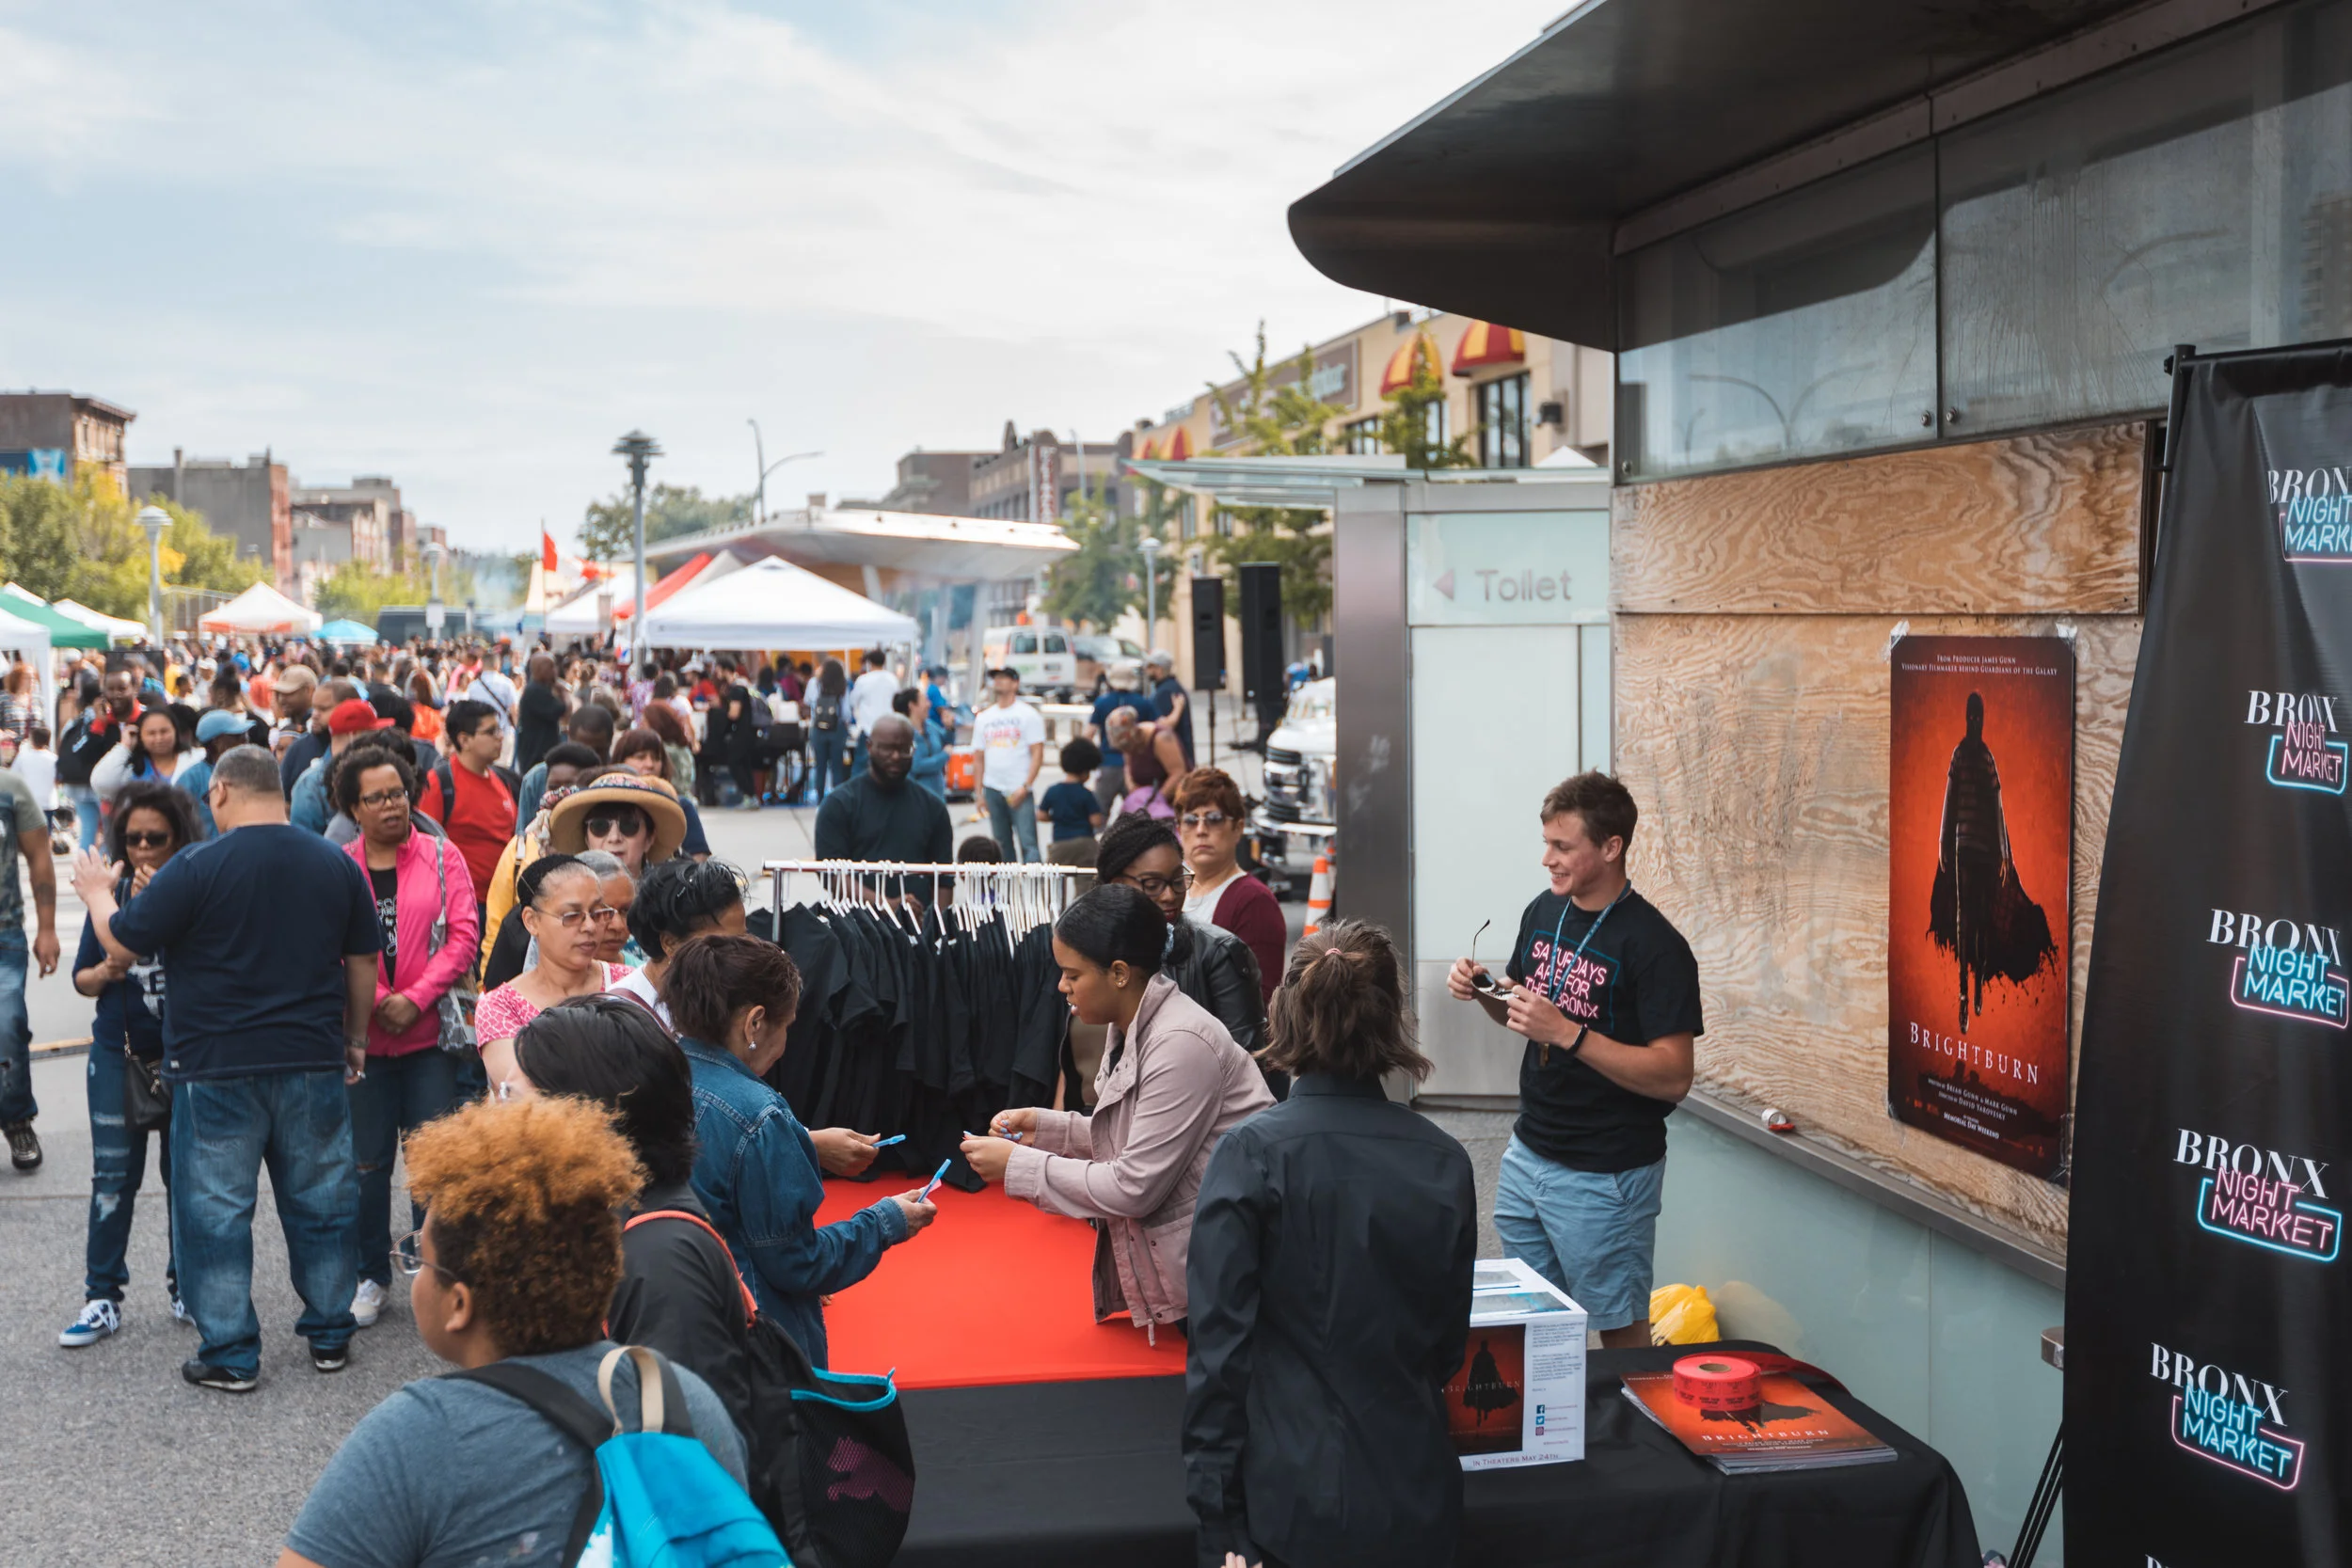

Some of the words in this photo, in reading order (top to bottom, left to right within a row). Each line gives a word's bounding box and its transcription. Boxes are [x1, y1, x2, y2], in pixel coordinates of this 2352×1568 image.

[2268, 466, 2352, 504] BRON
[2287, 496, 2352, 524] NIGHT
[2284, 524, 2352, 553] MARK
[1474, 568, 1572, 601] Toilet
[1999, 656, 2016, 665] GUNN
[2244, 689, 2339, 733] BRONX
[2285, 721, 2327, 752] NIGHT
[2281, 748, 2343, 784] MARKET
[2206, 908, 2342, 967] BRONX
[1532, 941, 1608, 987] SAURDAYS
[2248, 943, 2329, 983] NIGHT
[1564, 974, 1591, 1001] FOR
[2243, 970, 2346, 1019] MARKET
[1910, 1021, 2039, 1085] BRIGHTBURN
[2172, 1129, 2329, 1199] BRONX
[2216, 1166, 2300, 1212] NIGHT
[2211, 1194, 2334, 1250] MARKET
[2149, 1341, 2290, 1427] BRONX
[2185, 1384, 2264, 1436] NIGHT
[1701, 1429, 1830, 1441] BRIGHTBURN
[2183, 1411, 2294, 1478] MARKET
